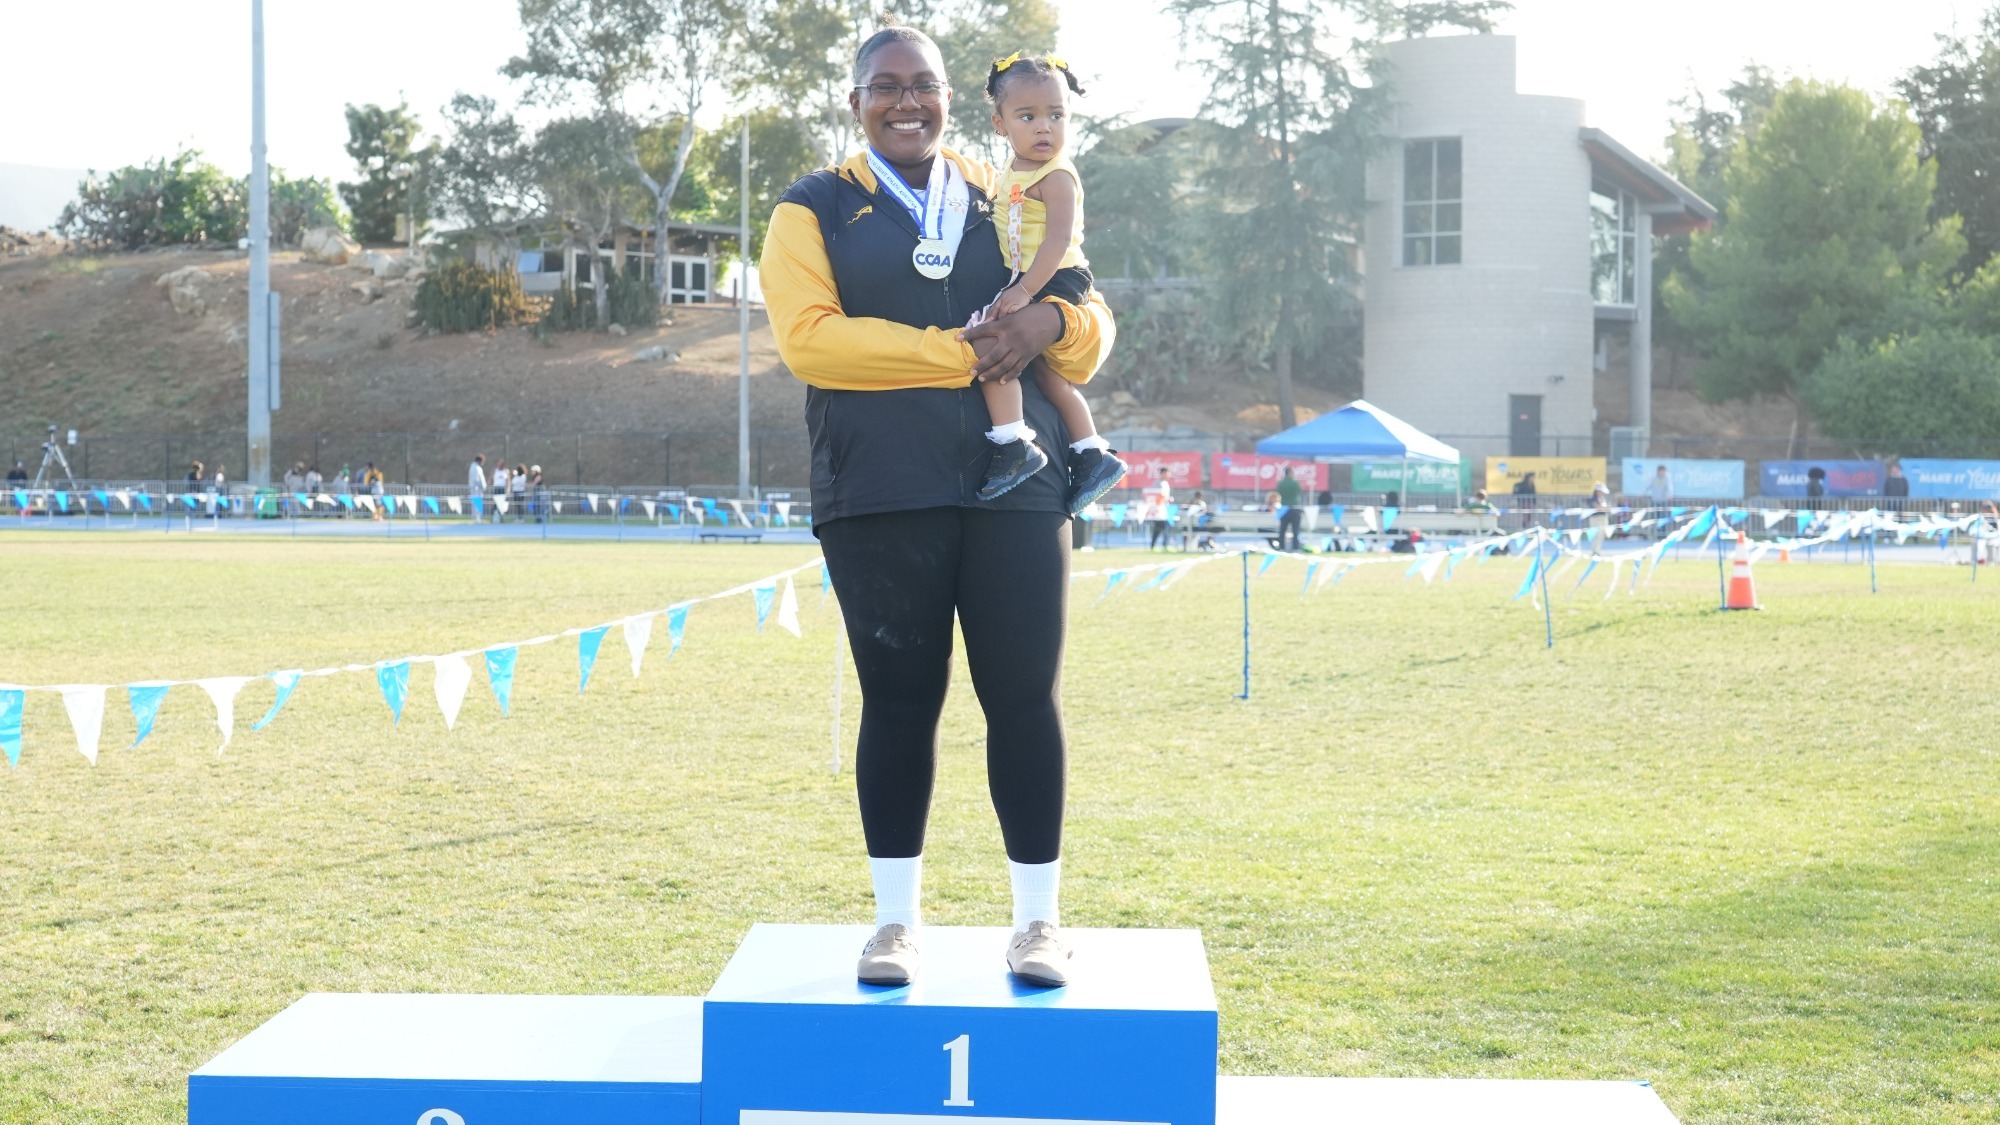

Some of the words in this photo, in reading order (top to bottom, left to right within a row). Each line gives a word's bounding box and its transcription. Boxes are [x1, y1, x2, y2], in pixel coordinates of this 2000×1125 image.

[915, 253, 951, 267] CCAA
[1538, 470, 1548, 480] IT
[1550, 463, 1594, 484] YOURS
[1826, 466, 1877, 490] YOURS
[1919, 472, 1952, 484] MAKE
[1954, 472, 1966, 484] IT
[943, 1034, 975, 1107] 1
